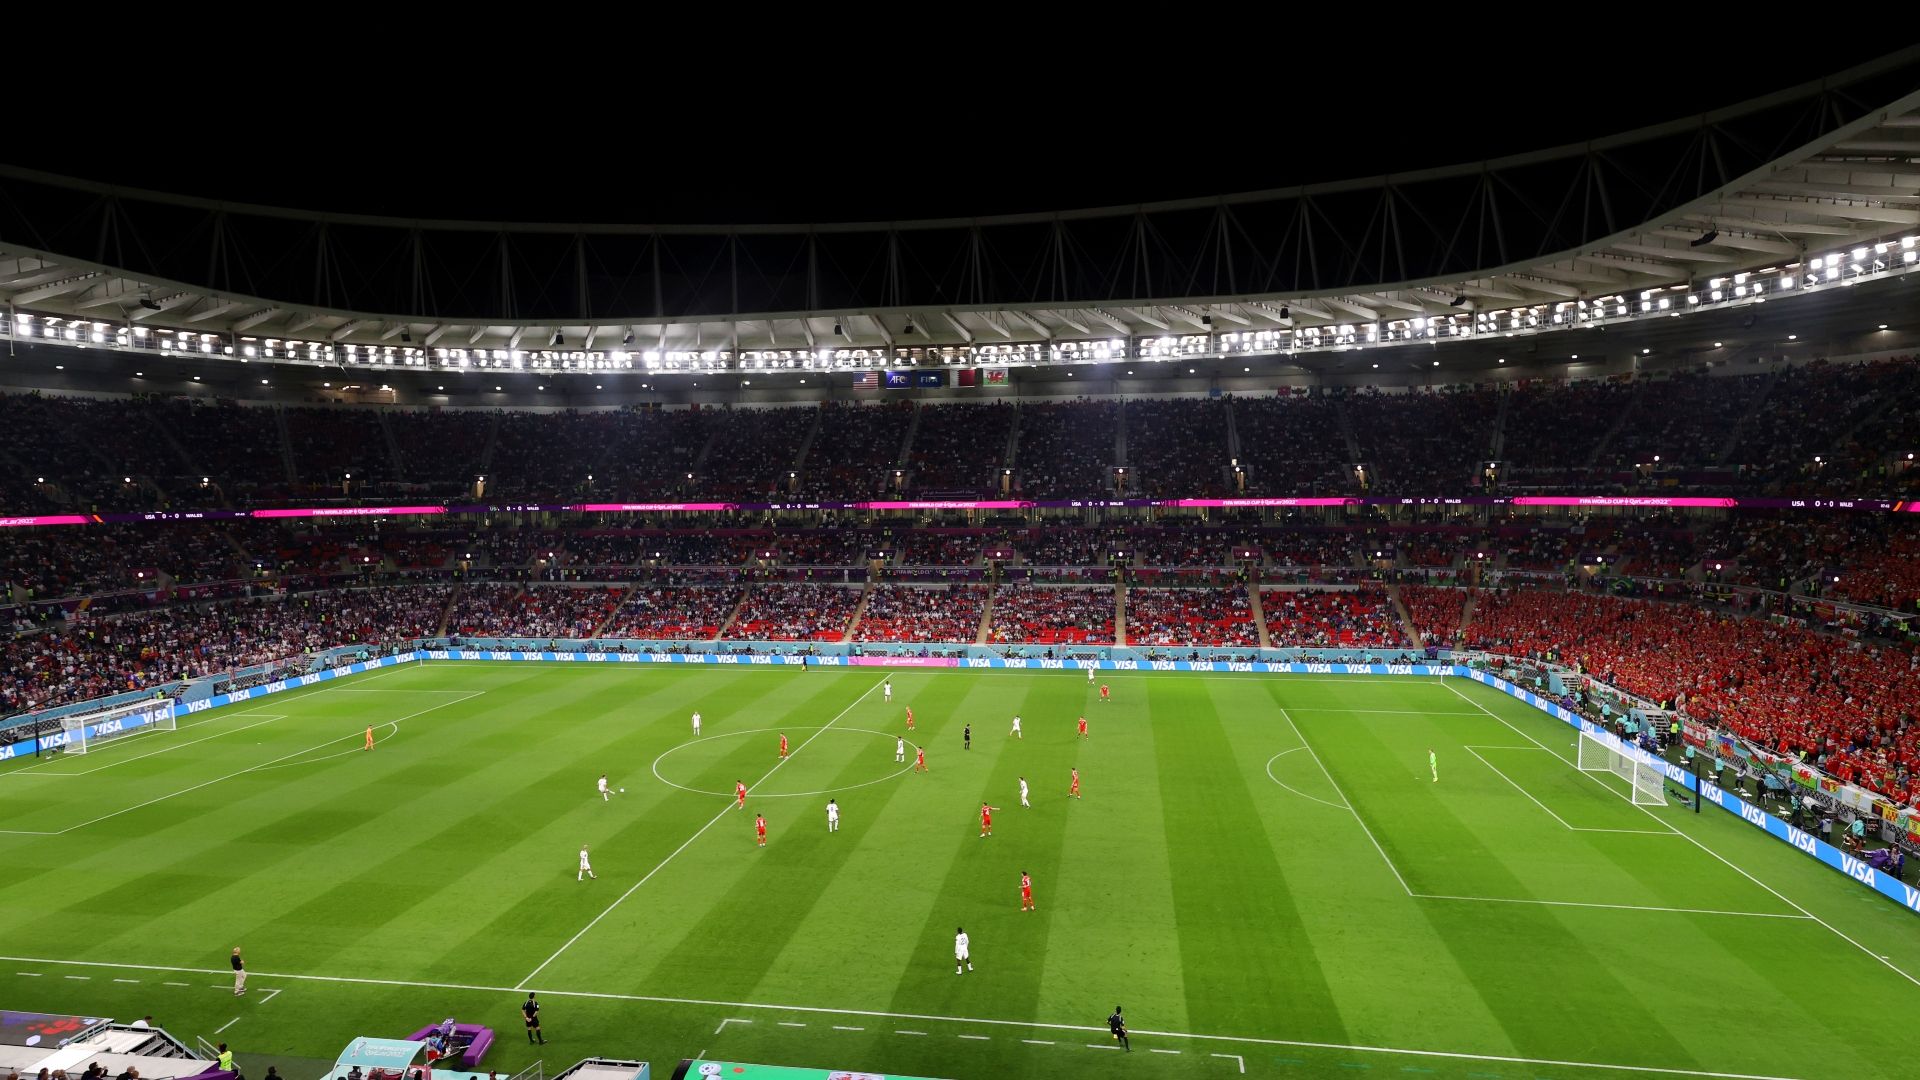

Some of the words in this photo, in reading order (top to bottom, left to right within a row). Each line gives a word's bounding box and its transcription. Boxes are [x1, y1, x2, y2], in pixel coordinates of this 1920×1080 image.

[889, 376, 906, 384] AFC
[394, 653, 414, 663] VISA
[429, 650, 449, 660] VISA
[459, 651, 480, 660] VISA
[490, 651, 511, 660] VISA
[522, 652, 543, 660] VISA
[553, 652, 575, 661] VISA
[585, 652, 607, 662] VISA
[617, 653, 639, 662] VISA
[650, 654, 672, 662] VISA
[683, 654, 704, 663] VISA
[716, 654, 738, 664] VISA
[750, 655, 771, 664] VISA
[783, 656, 804, 664] VISA
[363, 659, 381, 670] VISA
[817, 656, 839, 665] VISA
[968, 658, 990, 668] VISA
[1003, 658, 1026, 668] VISA
[1040, 659, 1063, 669] VISA
[1076, 660, 1100, 669] VISA
[1113, 660, 1137, 670] VISA
[1151, 661, 1175, 670] VISA
[333, 666, 351, 677] VISA
[1189, 662, 1213, 671] VISA
[1227, 662, 1252, 672] VISA
[1266, 663, 1291, 672] VISA
[1306, 664, 1331, 673] VISA
[1345, 664, 1371, 674] VISA
[1385, 665, 1412, 674] VISA
[1426, 666, 1454, 676] VISA
[300, 673, 320, 685] VISA
[1470, 669, 1484, 682] VISA
[265, 681, 286, 693] VISA
[1494, 676, 1506, 691] VISA
[228, 689, 250, 702] VISA
[1514, 686, 1526, 701] VISA
[187, 699, 211, 712] VISA
[1535, 696, 1547, 712] VISA
[143, 709, 169, 723] VISA
[1557, 707, 1570, 723] VISA
[93, 720, 122, 735] VISA
[1580, 718, 1595, 734] VISA
[39, 732, 71, 748] VISA
[1664, 762, 1685, 784] VISA
[1700, 780, 1723, 805] VISA
[1740, 800, 1766, 829] VISA
[1787, 825, 1816, 856] VISA
[1840, 852, 1875, 888] VISA
